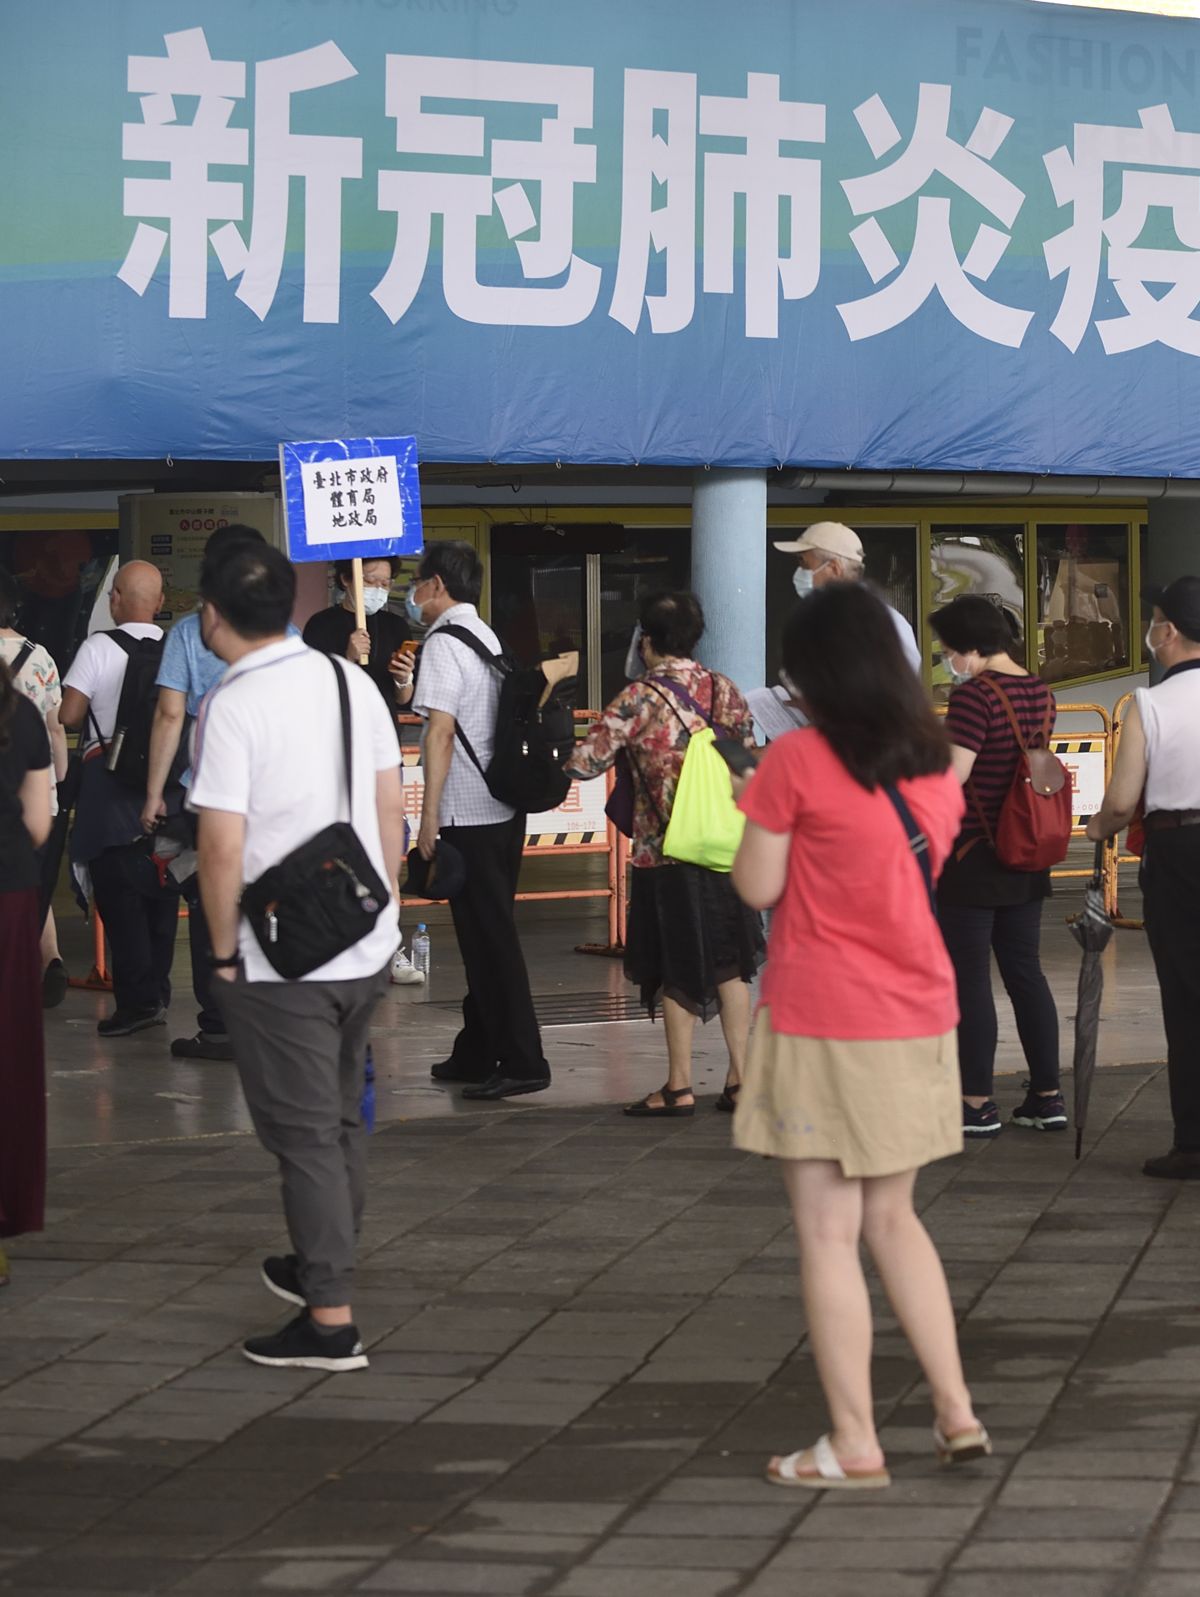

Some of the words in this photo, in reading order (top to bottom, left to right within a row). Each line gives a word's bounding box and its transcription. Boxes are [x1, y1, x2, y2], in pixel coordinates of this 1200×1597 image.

[955, 26, 1197, 98] FASHION
[313, 465, 388, 489] 臺北市政府
[330, 487, 375, 508] 體育局
[332, 508, 377, 528] 地政局
